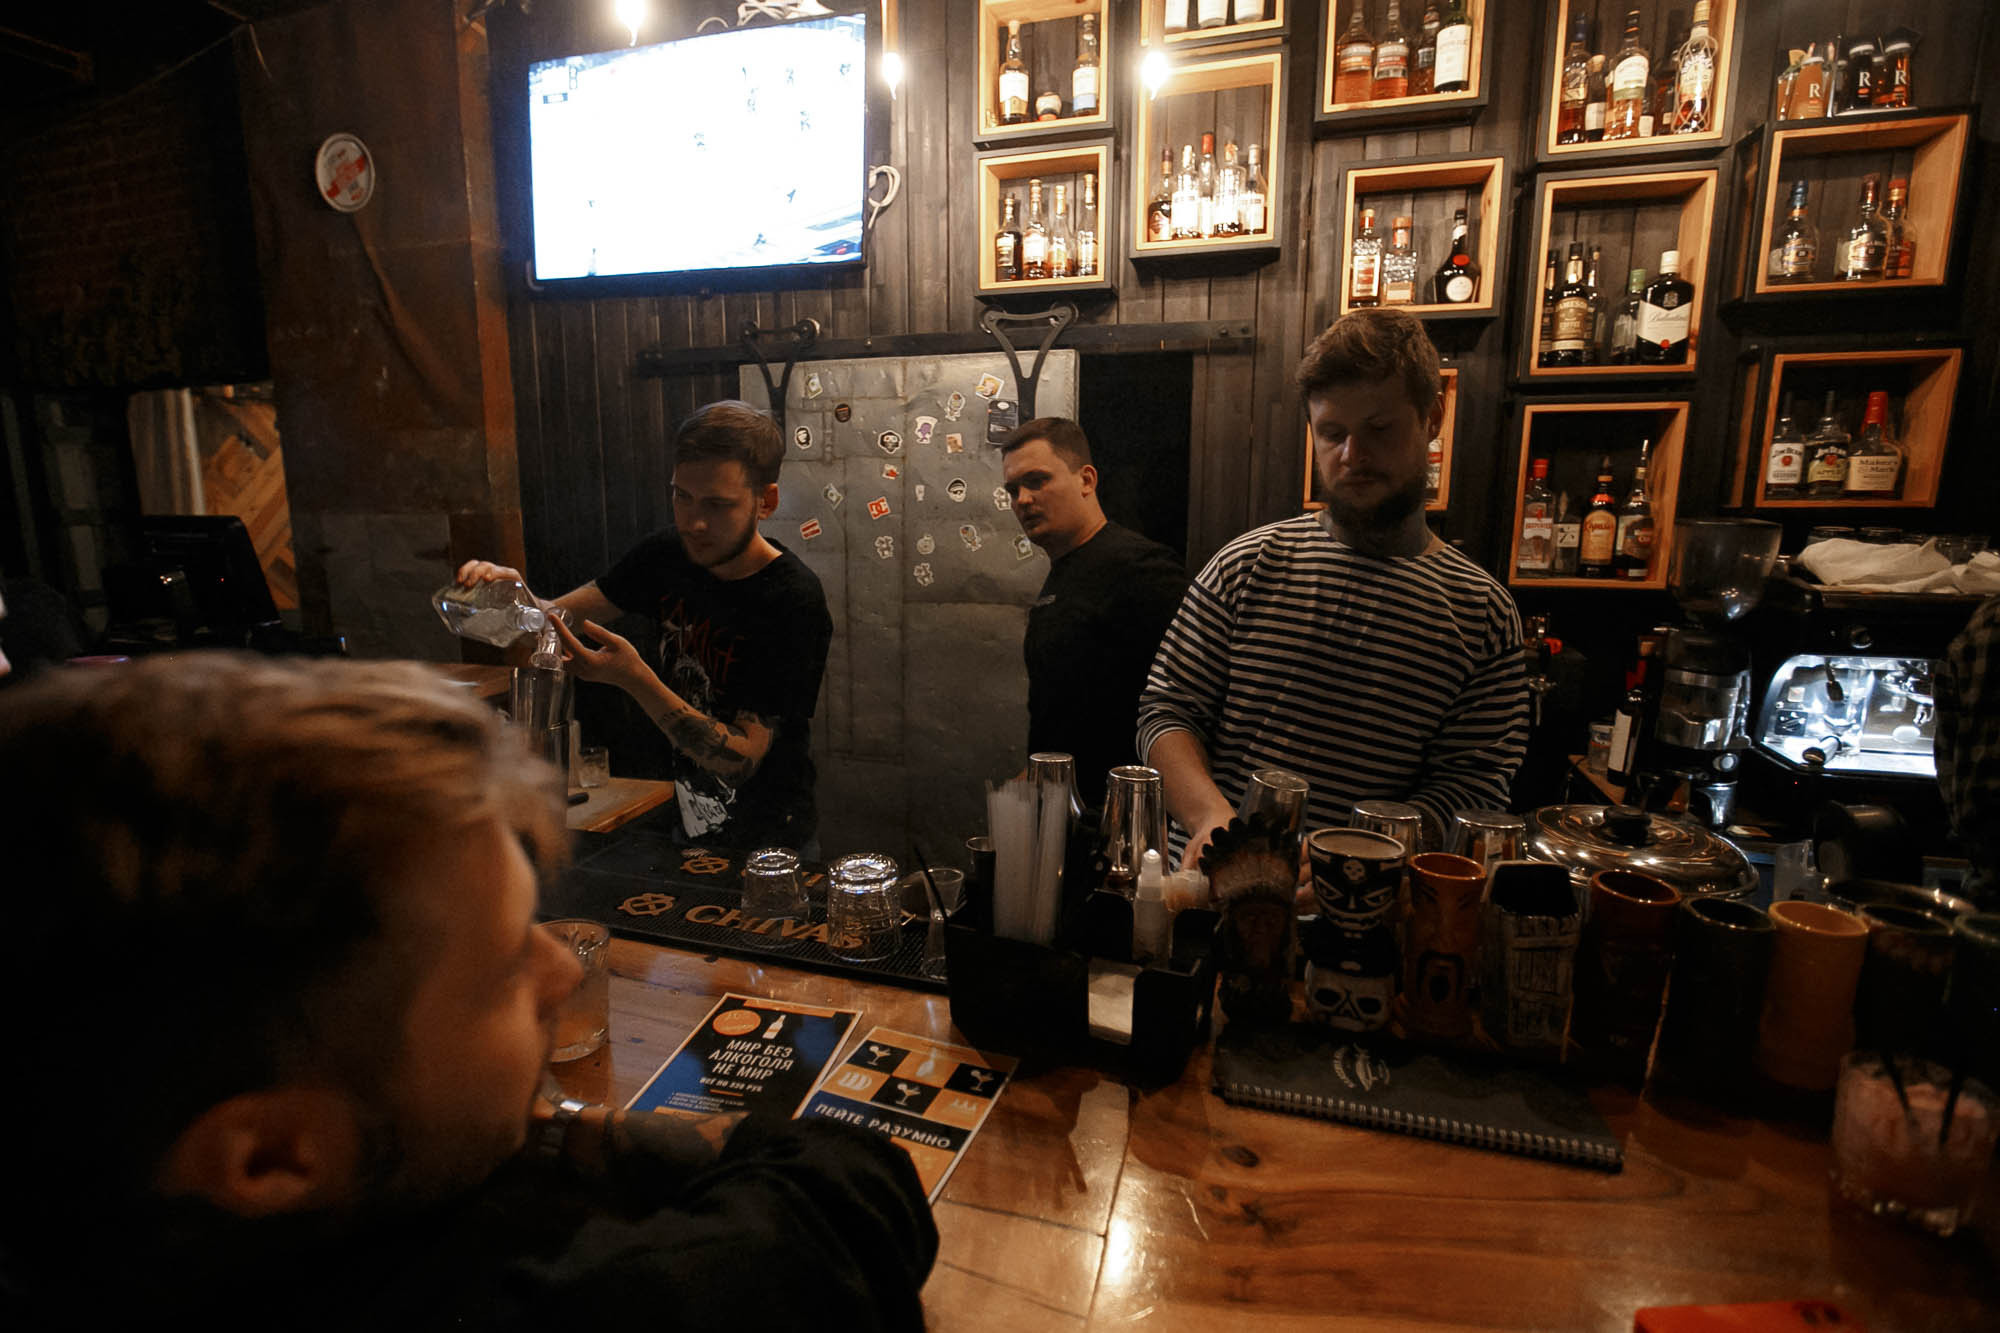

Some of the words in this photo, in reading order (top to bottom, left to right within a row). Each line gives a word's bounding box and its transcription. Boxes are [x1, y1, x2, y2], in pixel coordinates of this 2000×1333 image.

[1859, 71, 1871, 87] R
[1895, 70, 1907, 85] R
[1808, 83, 1820, 98] R
[726, 1040, 762, 1053] МИР
[763, 1044, 793, 1058] БЕЗ
[708, 1049, 794, 1071] АЛКОГОЛЯ
[712, 1062, 736, 1075] НЕ
[736, 1065, 774, 1080] МИР
[815, 1103, 865, 1125] ПЕЙТЕ
[868, 1118, 951, 1149] РАЗУМНО
